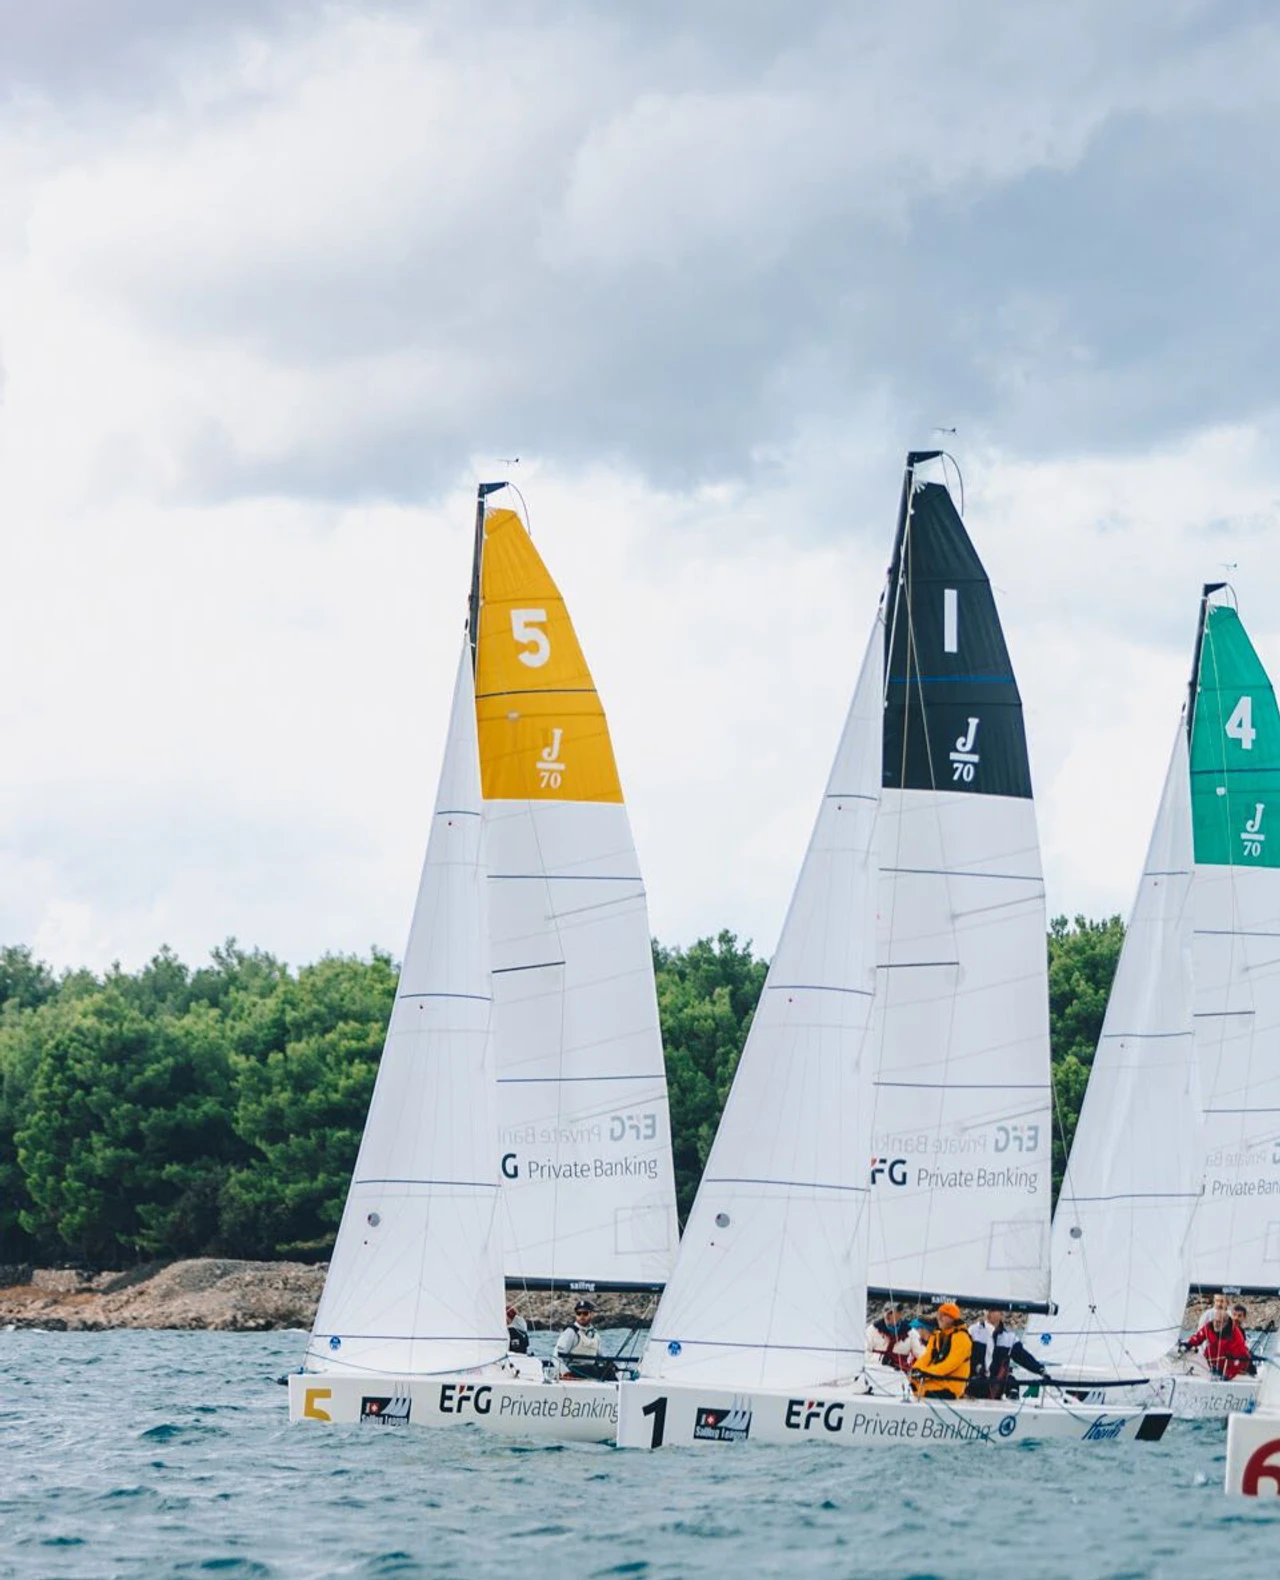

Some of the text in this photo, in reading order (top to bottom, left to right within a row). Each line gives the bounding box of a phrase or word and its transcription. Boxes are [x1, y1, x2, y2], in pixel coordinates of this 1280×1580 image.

[943, 588, 958, 653] 1
[509, 608, 550, 668] 5
[956, 717, 980, 752] J
[1225, 696, 1256, 750] 4
[541, 728, 563, 761] J
[539, 771, 562, 789] 70
[952, 763, 975, 782] 70
[1246, 803, 1265, 832] J
[1243, 841, 1261, 857] 70
[528, 1158, 591, 1179] Private
[593, 1155, 658, 1180] Banking
[870, 1156, 1038, 1194] FG Private Banking
[1212, 1178, 1256, 1196] Private
[304, 1388, 332, 1422] 5
[439, 1384, 492, 1415] EFG
[500, 1395, 559, 1418] Private
[641, 1396, 668, 1449] 1
[785, 1399, 992, 1442] EFG Private Banking
